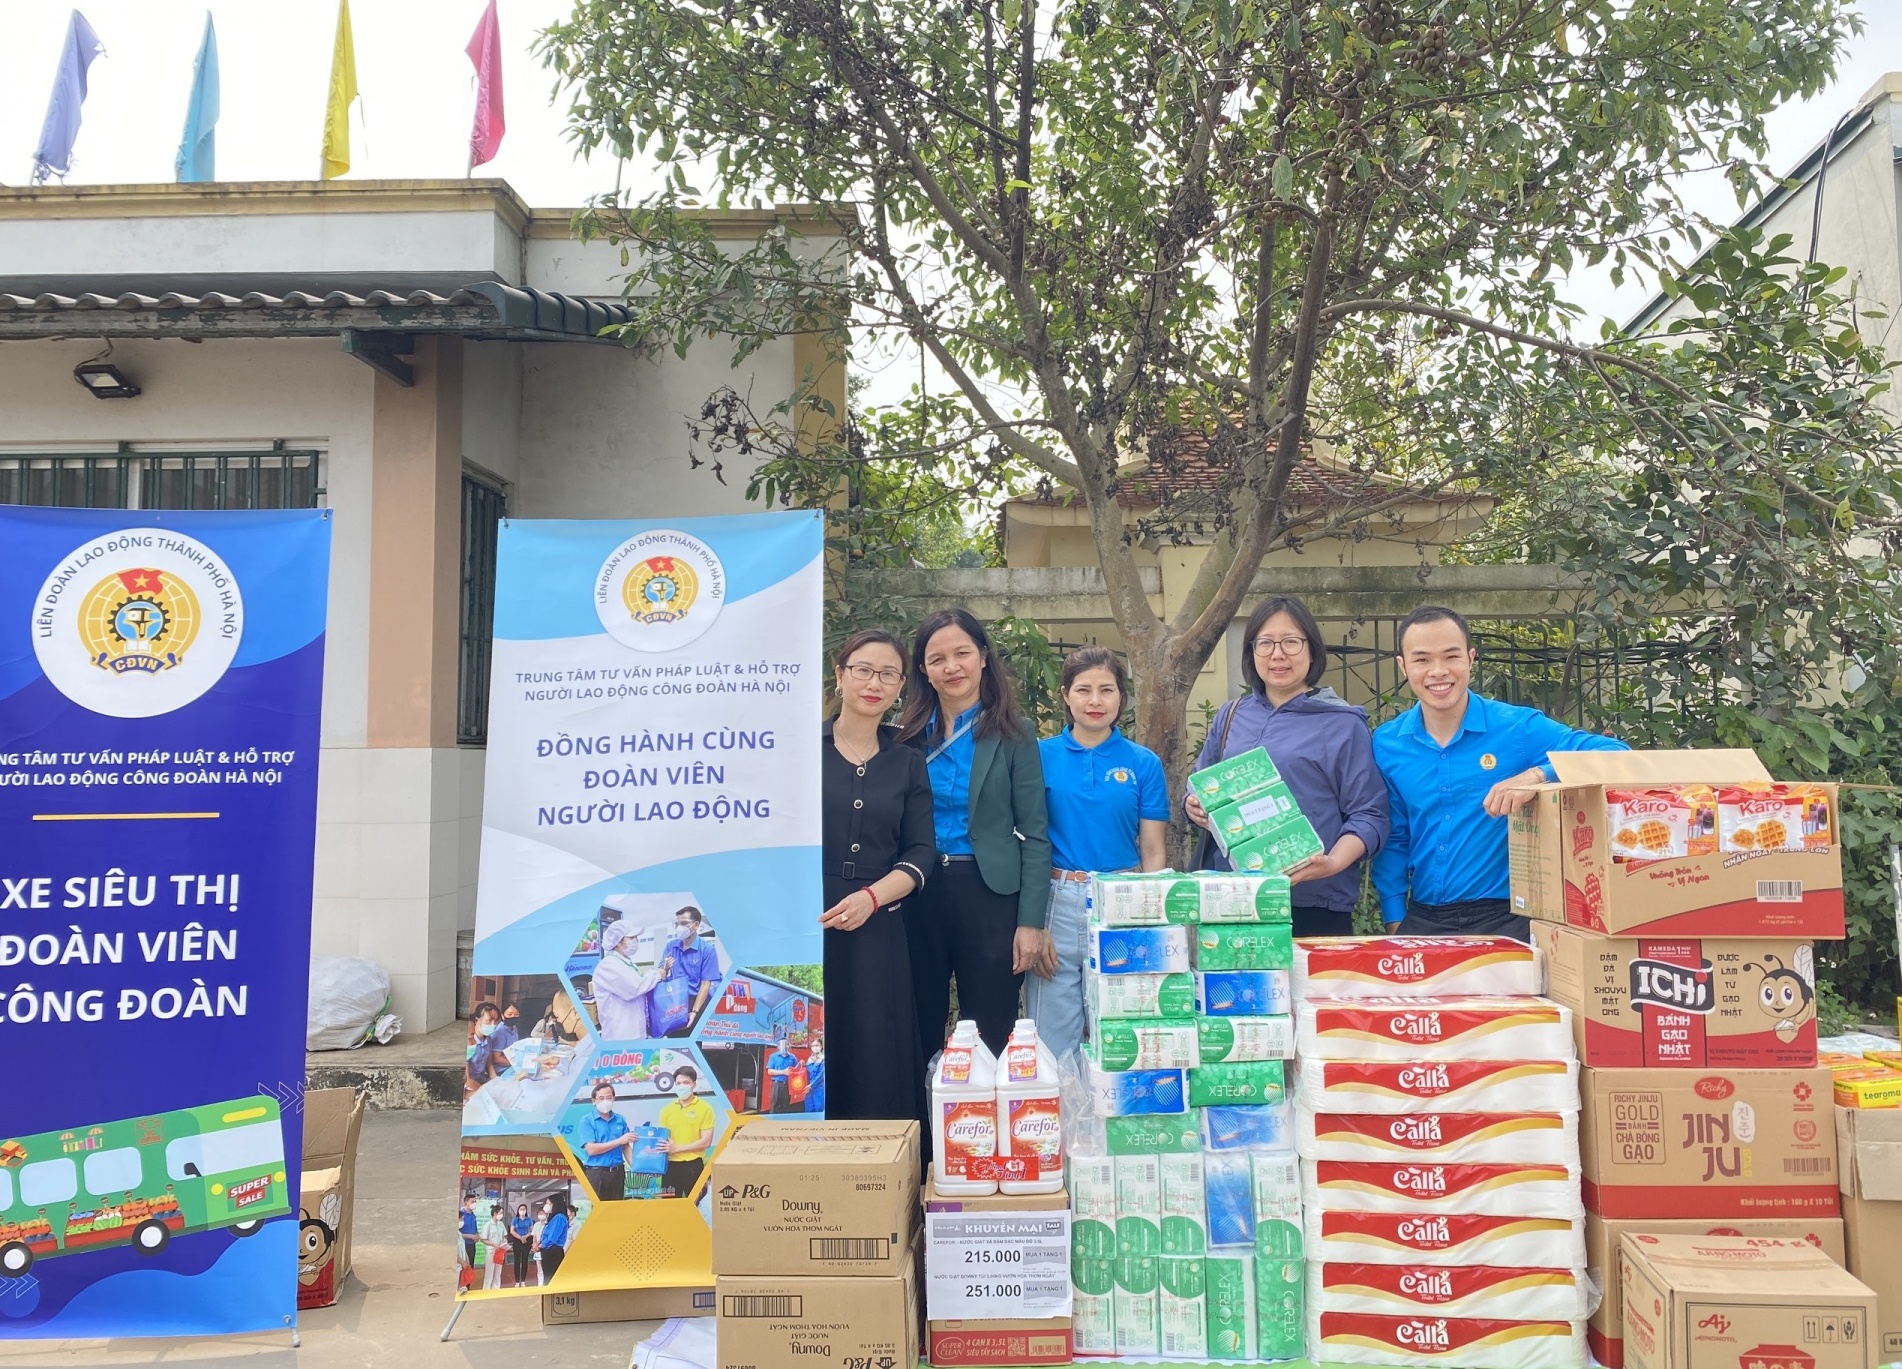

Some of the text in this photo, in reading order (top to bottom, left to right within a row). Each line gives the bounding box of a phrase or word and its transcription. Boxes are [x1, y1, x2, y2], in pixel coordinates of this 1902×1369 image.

[597, 534, 723, 605] LIÊN ĐOÀN LAO ĐỘNG THÀNH PHỐ HÀ NỘI
[37, 535, 237, 640] LIÊN ĐOÀN LAO ĐỘNG THÀNH PHỐ HÀ NỘI
[114, 656, 158, 672] CĐVN
[515, 659, 801, 684] TRUNG TÂM TƯ VẤN PHÁP LUẬT & HỖ TRỢ
[524, 678, 791, 702] NGƯỜI LAO ĐỘNG CÔNG ĐOÀN HÀ NỘI
[536, 726, 776, 758] ĐỒNG HÀNH CÙNG
[23, 750, 58, 766] TÂM
[61, 751, 86, 765] TƯ
[89, 748, 124, 765] VẤN
[127, 749, 170, 765] PHÁP
[174, 748, 213, 767] LUẬT
[217, 751, 231, 765] &
[234, 747, 258, 764] HỖ
[262, 750, 295, 766] TRỢ
[33, 773, 66, 786] LAO
[69, 770, 119, 788] ĐỘNG
[123, 770, 170, 785] CÔNG
[173, 769, 221, 785] ĐOÀN
[225, 769, 249, 784] HÀ
[252, 768, 282, 786] NỘI
[583, 761, 725, 789] ĐOÀN VIÊN
[537, 794, 771, 826] NGƯỜI LAO ĐỘNG
[1623, 799, 1669, 817] Karo
[1740, 800, 1784, 817] Karo
[1572, 825, 1594, 843] Karo
[1687, 874, 1710, 884] Ngon
[0, 867, 240, 913] XE SIÊU THỊ
[0, 921, 238, 966] ĐOÀN VIÊN
[1227, 936, 1275, 948] CORELEX
[1600, 952, 1618, 963] ĐẬM
[1717, 953, 1740, 963] ĐƯỢC
[1721, 966, 1738, 975] LÀM
[1605, 976, 1614, 985] VỊ
[1594, 986, 1627, 995] SHOUYU
[0, 977, 248, 1024] ÔNG ĐOÀN
[1601, 995, 1619, 1006] MẬT
[1722, 995, 1740, 1004] GẠO
[1656, 1013, 1691, 1026] BÁNH
[1720, 1006, 1742, 1018] NHẬT
[1661, 1029, 1688, 1042] GẠO
[1658, 1041, 1692, 1057] NHẬT
[1699, 1078, 1728, 1098] Richy
[1864, 1089, 1902, 1100] tearoma
[1613, 1094, 1659, 1104] RICHY JINJU
[1615, 1103, 1660, 1121] GOLD
[946, 1121, 992, 1140] Carefor
[1012, 1118, 1057, 1137] Carefor
[1628, 1121, 1647, 1130] BÁNH
[1682, 1113, 1731, 1150] JIN
[1616, 1132, 1660, 1144] CHÀ BÔNG
[481, 1151, 498, 1163] SỨC
[1622, 1143, 1655, 1164] GẠO
[468, 1163, 486, 1174] SỨC
[487, 1163, 509, 1176] KHỎE
[511, 1167, 531, 1176] SINH
[550, 1167, 561, 1177] VÀ
[1702, 1146, 1742, 1182] JU
[228, 1176, 270, 1199] SUPER
[723, 1184, 771, 1199] UP P&G
[238, 1190, 264, 1207] SALE
[782, 1200, 822, 1214] Downy
[823, 1224, 843, 1232] NGÁT
[965, 1220, 1016, 1234] KHUYẾN
[1017, 1223, 1043, 1235] MẠI
[1046, 1222, 1061, 1230] SALE
[964, 1250, 1021, 1263] 215.000
[965, 1284, 1022, 1297] 251.000
[566, 1296, 575, 1307] kg
[1219, 1273, 1232, 1325] CORELEX
[1283, 1290, 1296, 1343] CORELEX
[1697, 1313, 1732, 1334] Aj
[791, 1341, 831, 1356] Downy
[940, 1348, 963, 1356] CLEAN
[941, 1341, 962, 1349] SUPER
[880, 1357, 892, 1367] UP
